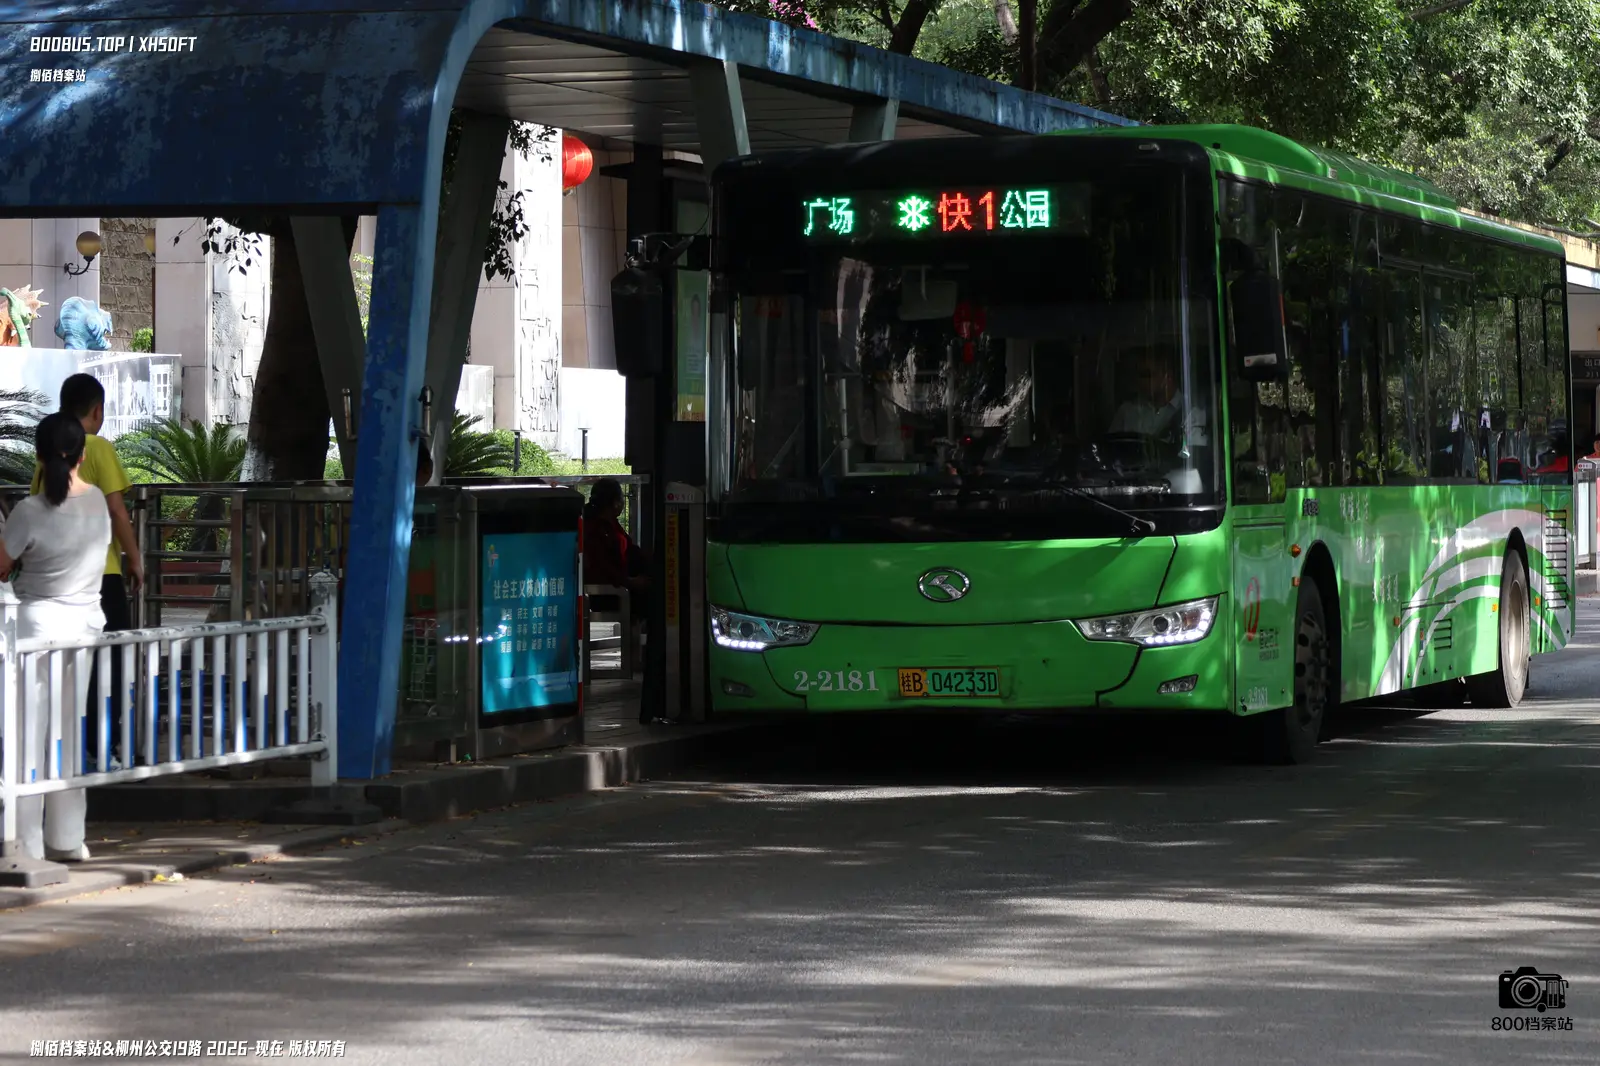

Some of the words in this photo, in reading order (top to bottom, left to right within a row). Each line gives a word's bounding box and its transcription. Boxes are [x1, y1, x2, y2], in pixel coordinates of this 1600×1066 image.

[803, 197, 854, 236] 广场
[1000, 190, 1050, 229] 公园
[493, 577, 565, 600] 社会主义核心价值观
[793, 670, 880, 692] 2-2181
